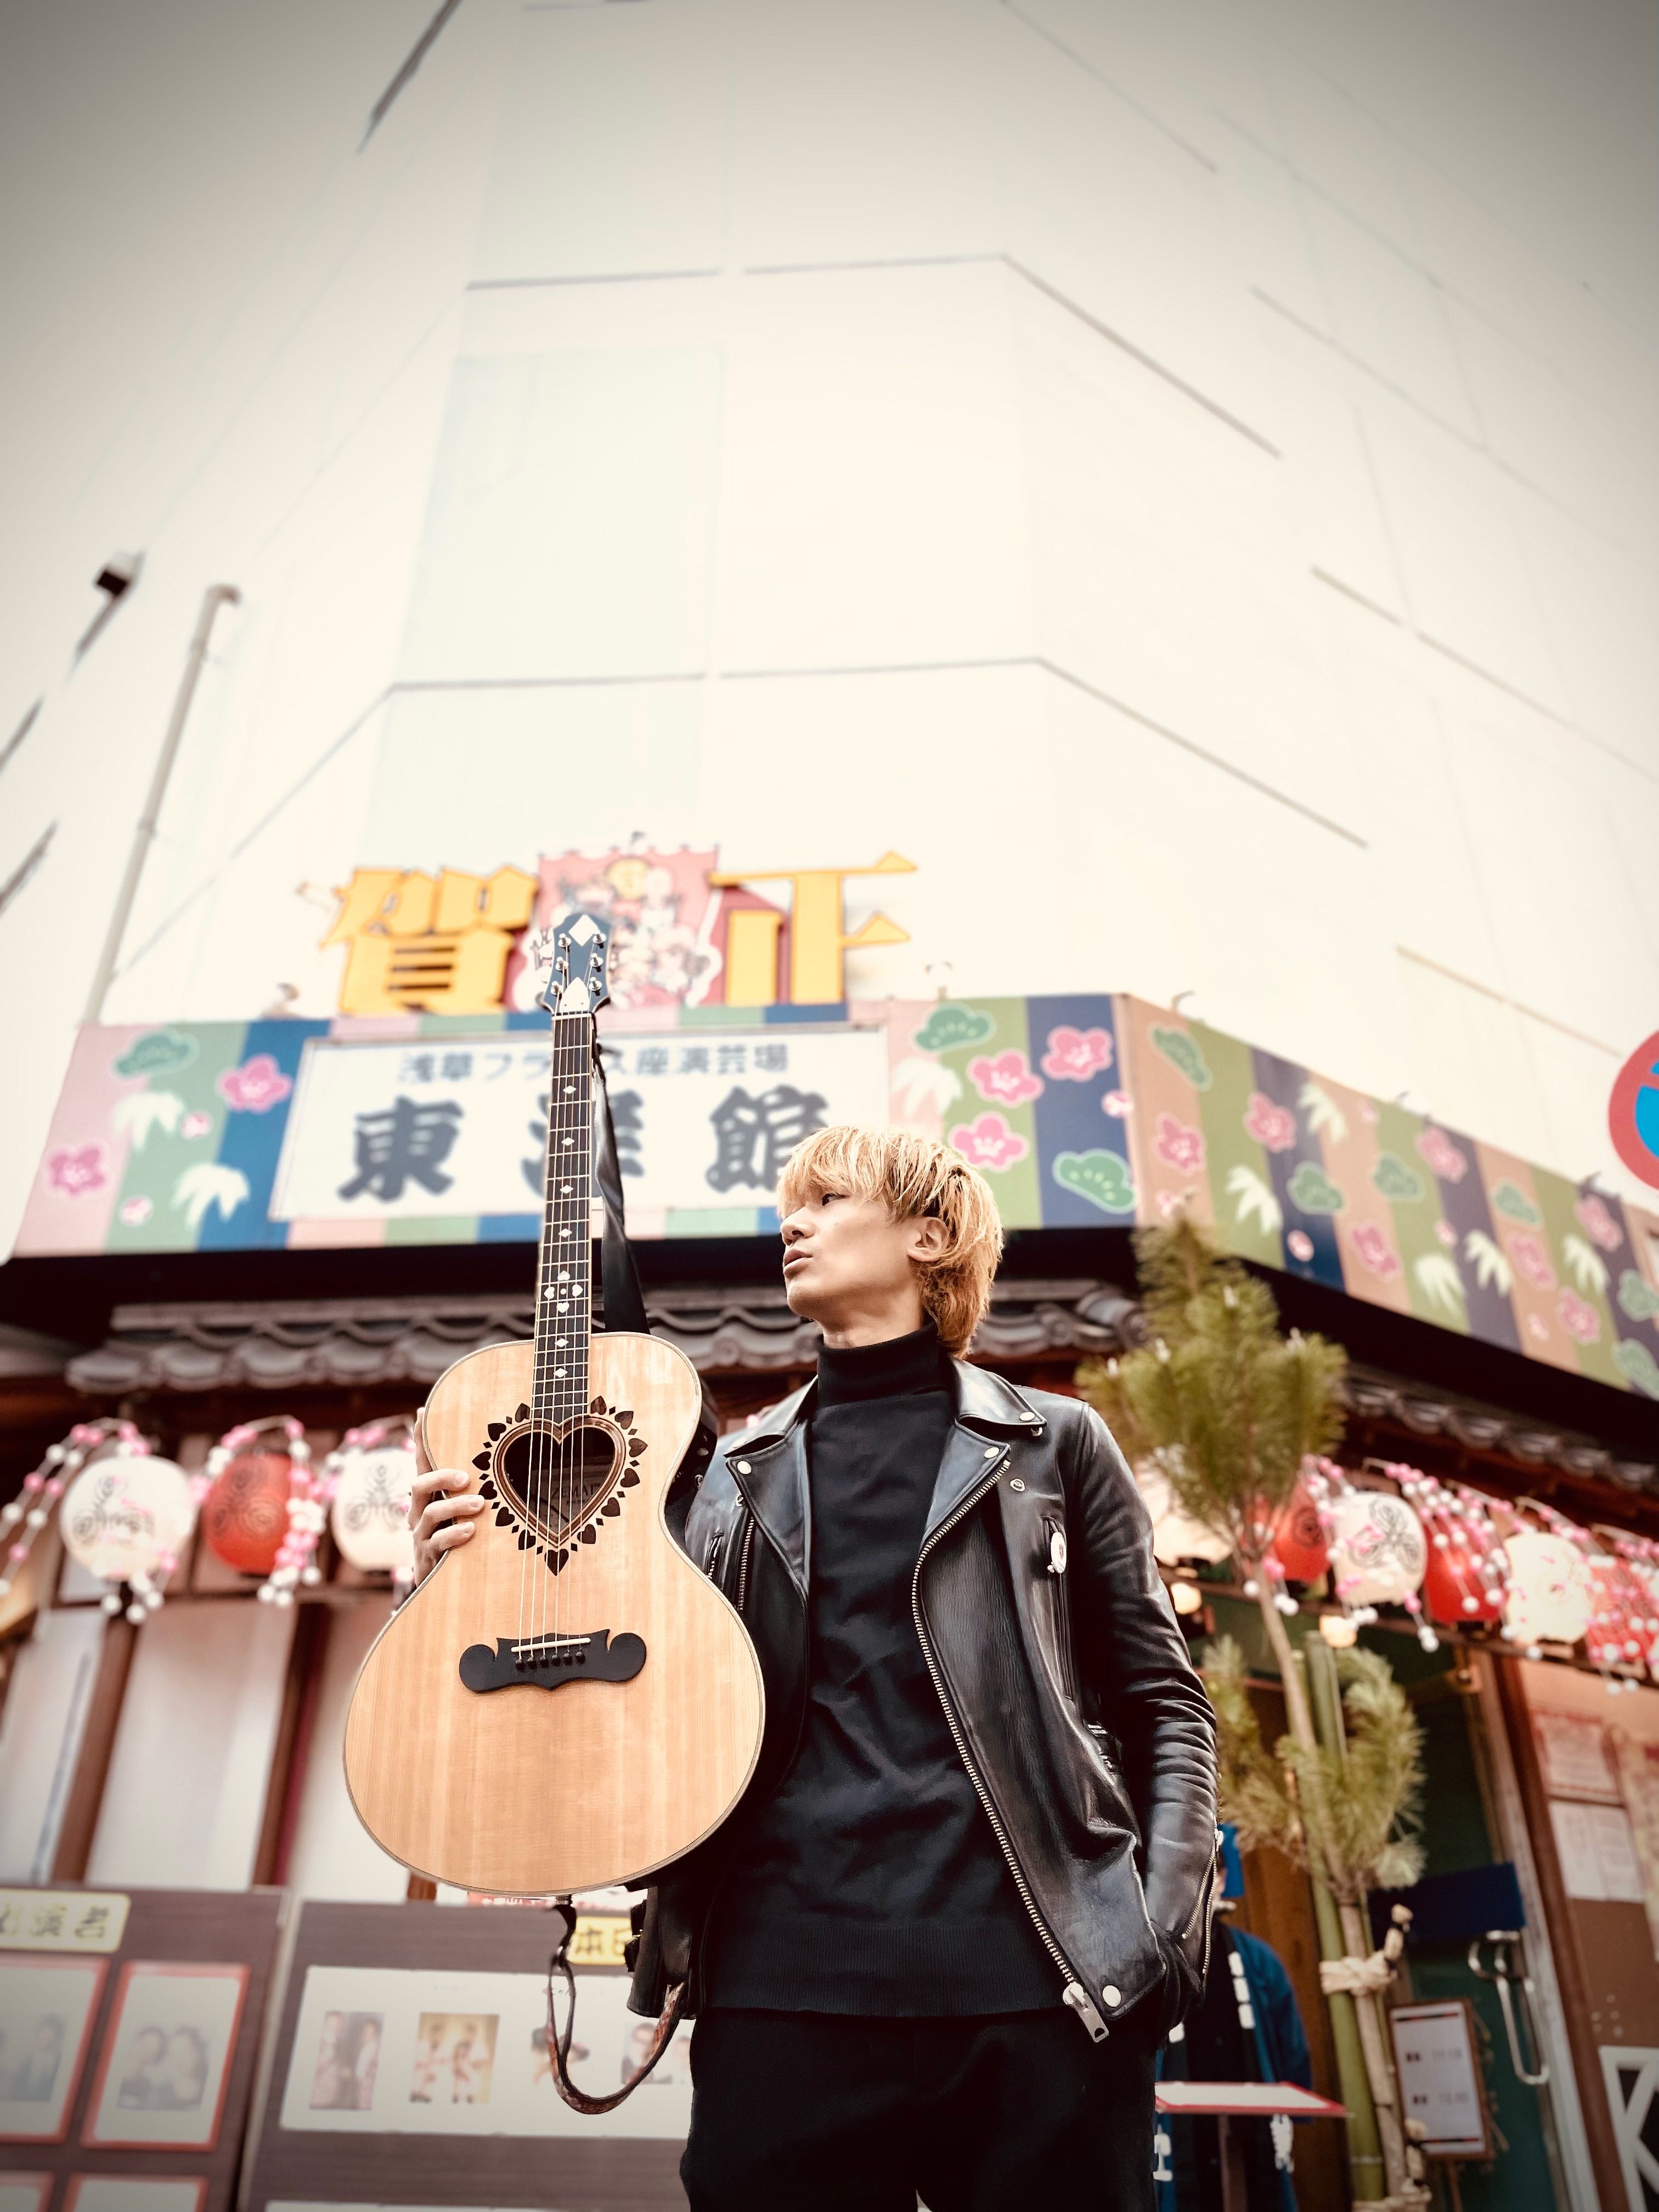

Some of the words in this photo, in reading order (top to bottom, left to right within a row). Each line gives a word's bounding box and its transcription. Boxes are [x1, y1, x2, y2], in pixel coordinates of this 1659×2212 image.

[398, 1043, 789, 1083] 浅草フラス座演芸場
